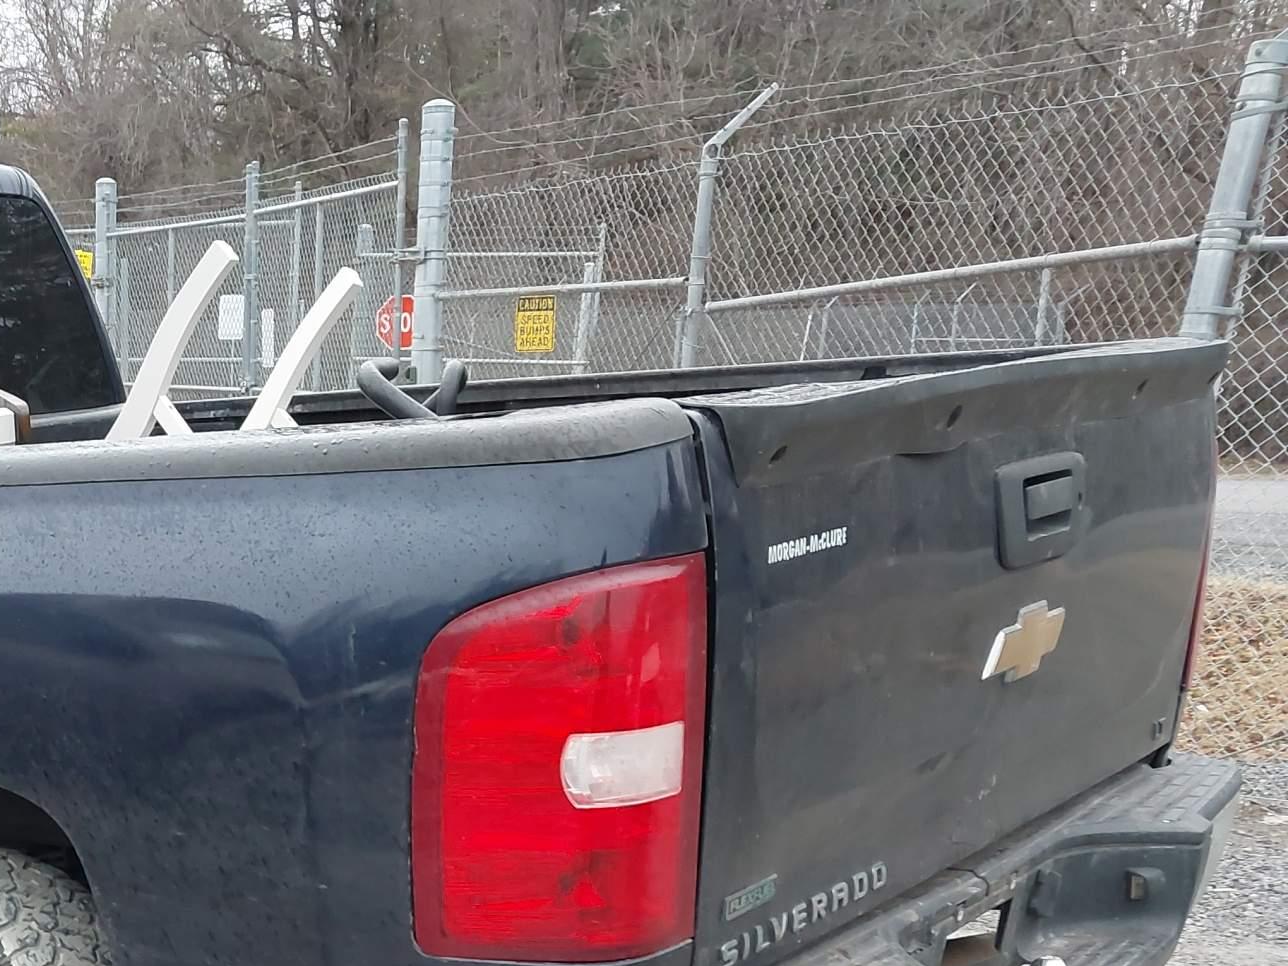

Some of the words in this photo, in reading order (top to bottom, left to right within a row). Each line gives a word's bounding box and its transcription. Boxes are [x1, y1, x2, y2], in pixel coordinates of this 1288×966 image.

[519, 299, 553, 310] CAUTION
[380, 312, 414, 333] SO
[520, 314, 550, 325] SPEED
[519, 325, 550, 337] BUMPS
[519, 336, 549, 347] AHEAD
